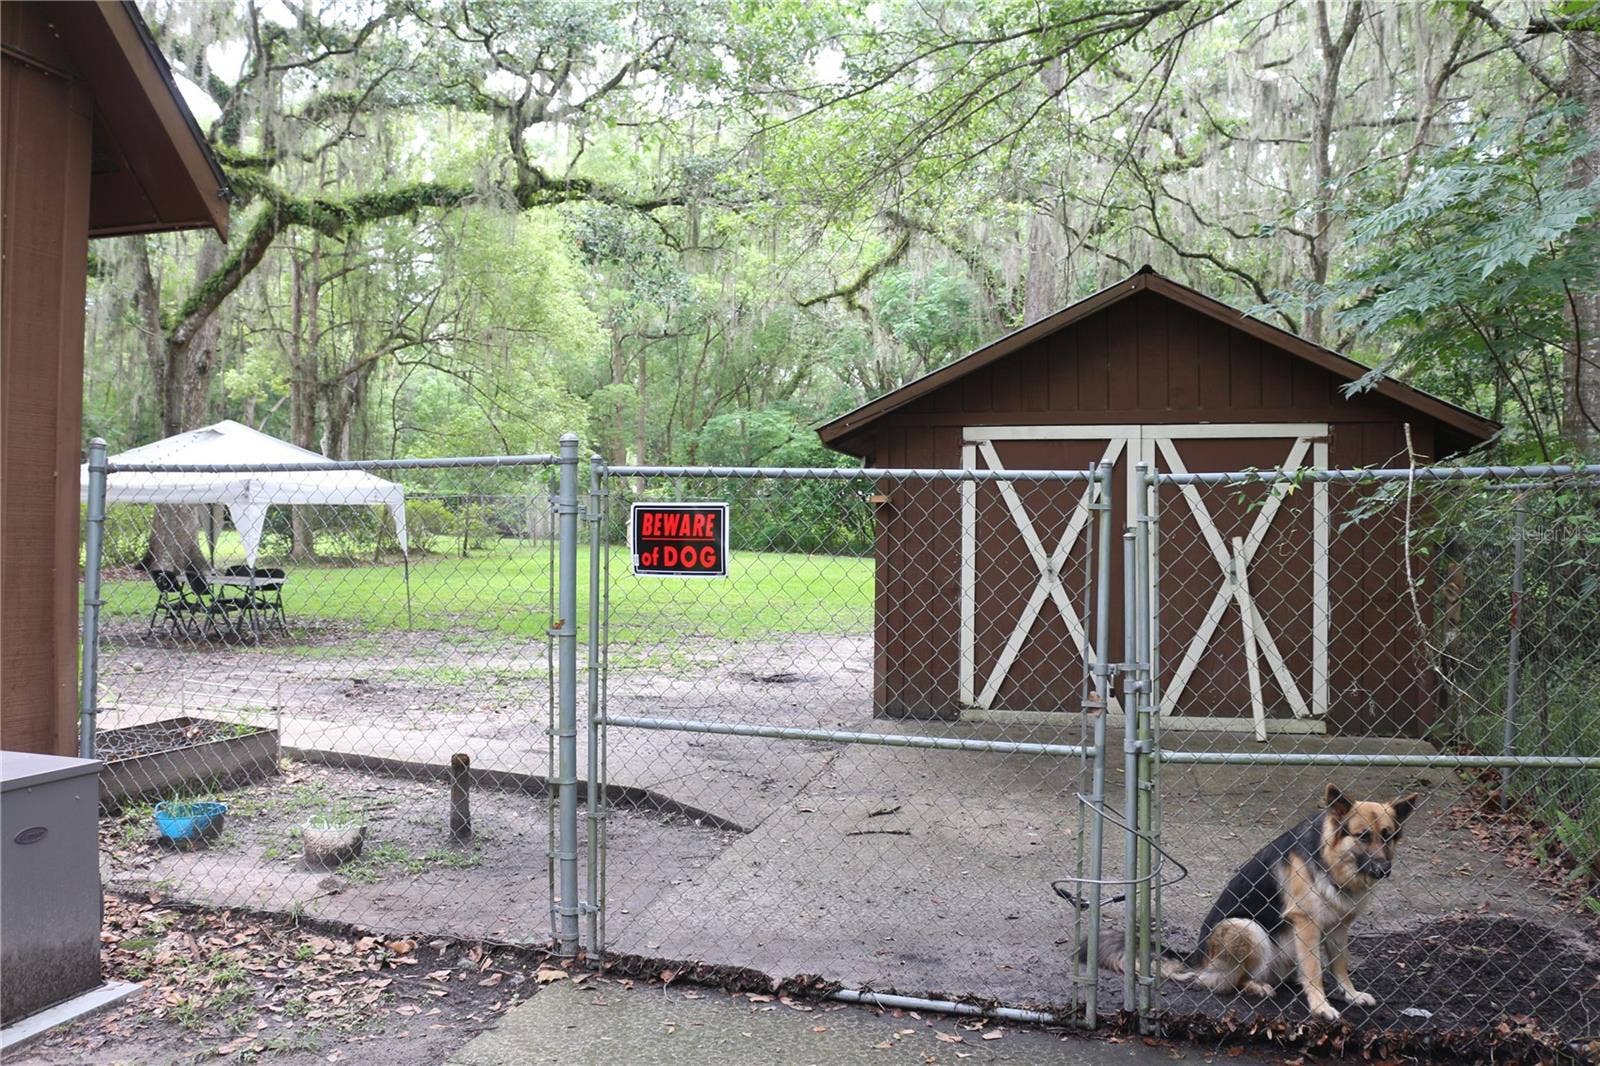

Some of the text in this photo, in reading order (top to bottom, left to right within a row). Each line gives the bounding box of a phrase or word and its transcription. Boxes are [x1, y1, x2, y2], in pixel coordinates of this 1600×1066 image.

[641, 512, 716, 537] BEWARE
[641, 545, 716, 568] of DOG
